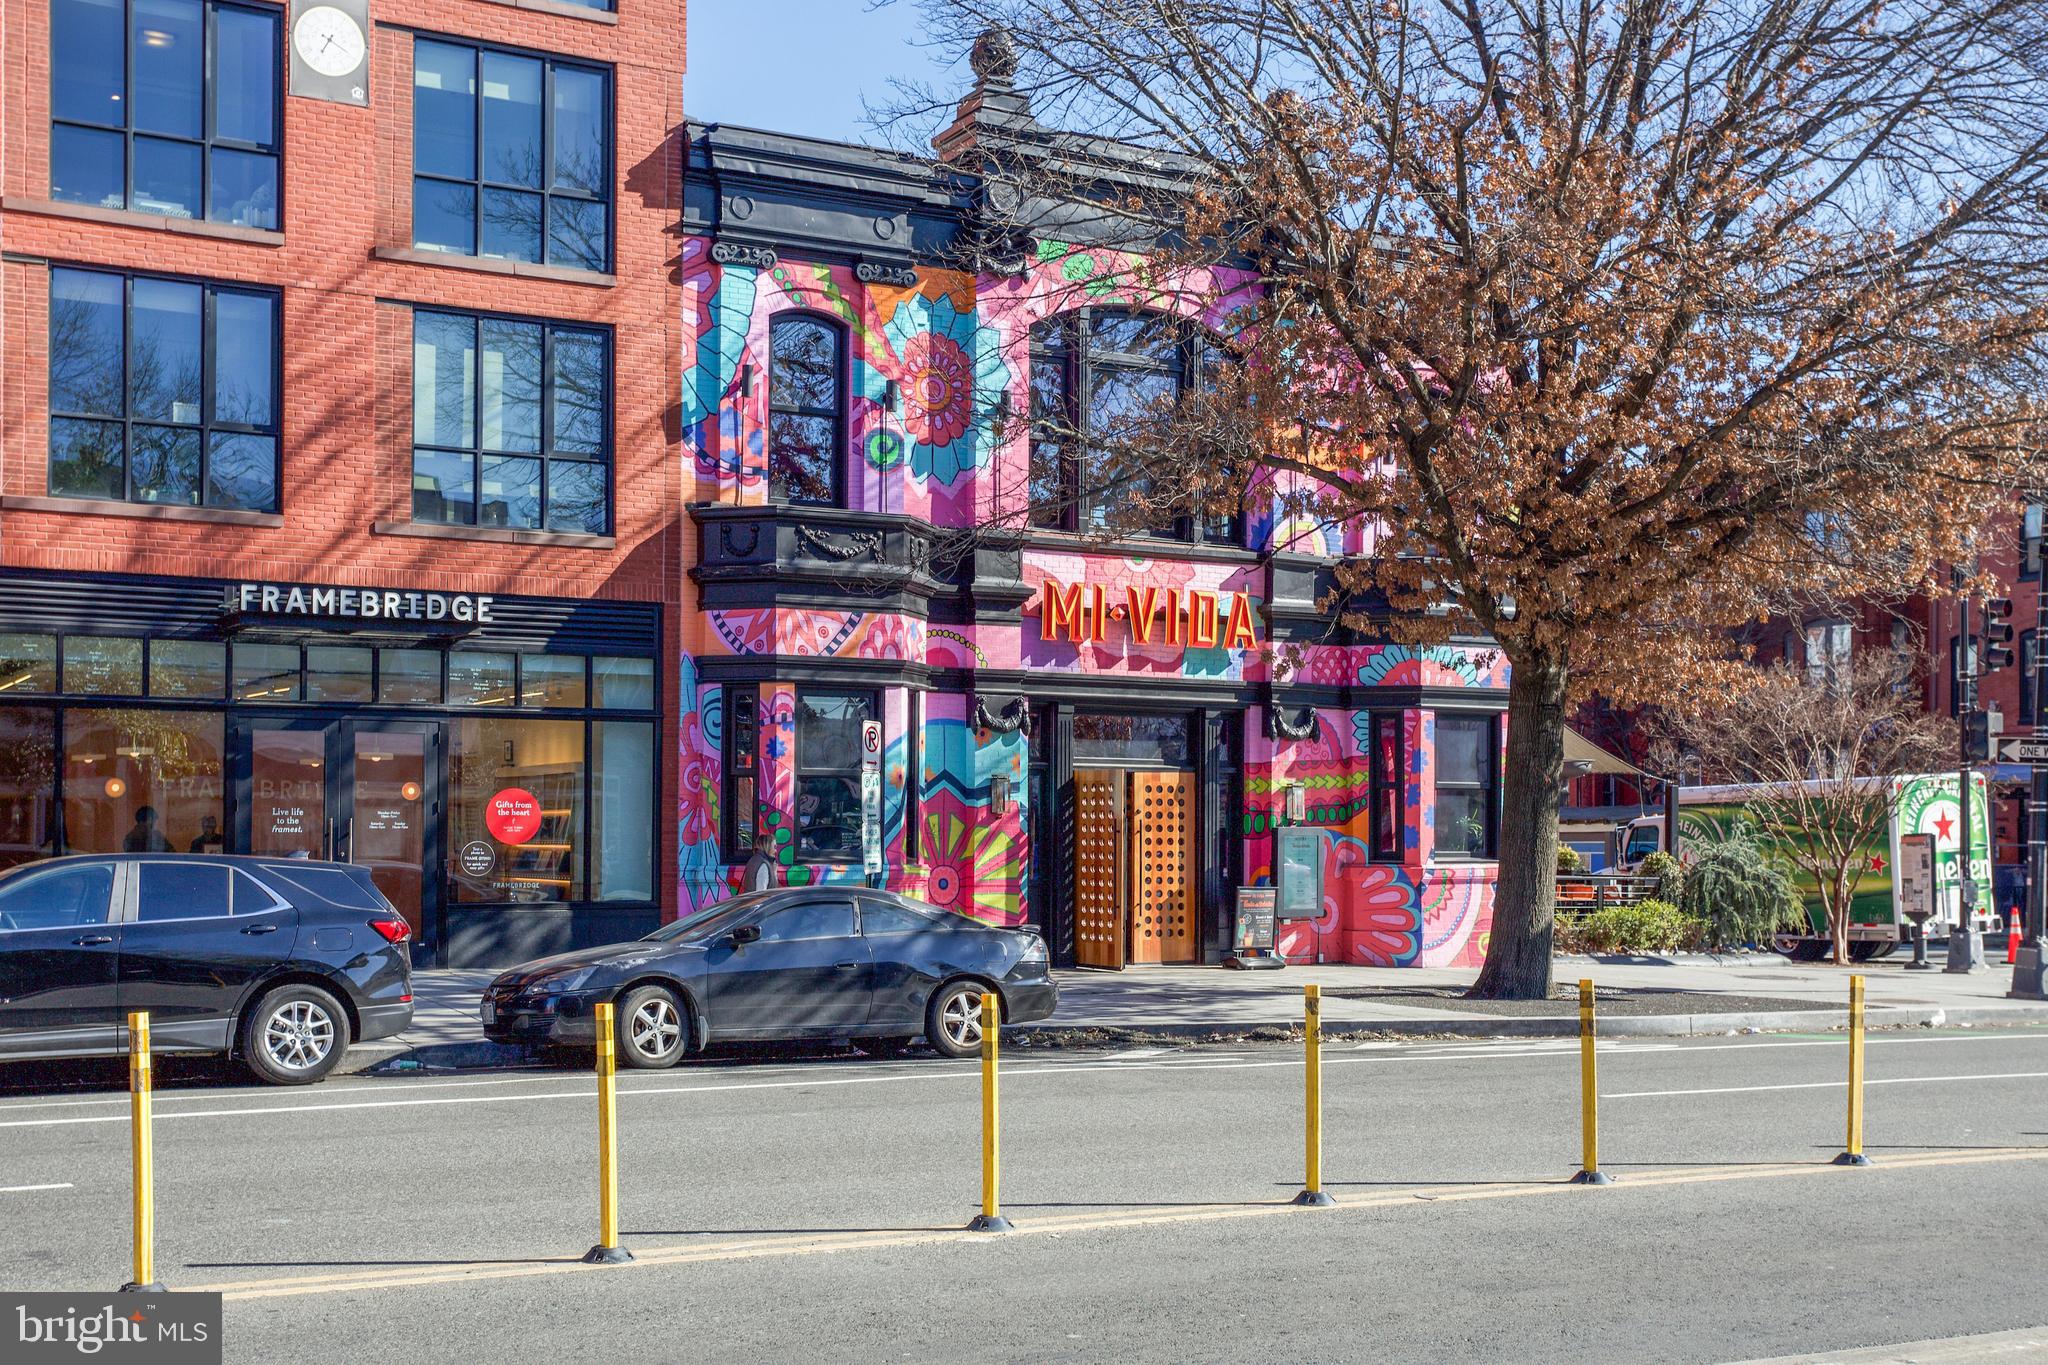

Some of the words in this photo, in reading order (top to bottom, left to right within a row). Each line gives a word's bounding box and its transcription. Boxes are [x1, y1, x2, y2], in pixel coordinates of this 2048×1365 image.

[240, 584, 494, 622] FRAMEBRIDGE
[1041, 579, 1107, 642] MI
[1126, 585, 1258, 650] VIDA
[2020, 746, 2040, 757] ONE
[495, 800, 513, 808] Gifts
[515, 800, 532, 808] from
[272, 807, 289, 816] Live
[291, 807, 304, 816] life
[497, 808, 510, 816] the
[511, 808, 530, 816] heart
[277, 817, 285, 825] to
[287, 816, 300, 825] the
[271, 825, 303, 833] framest.
